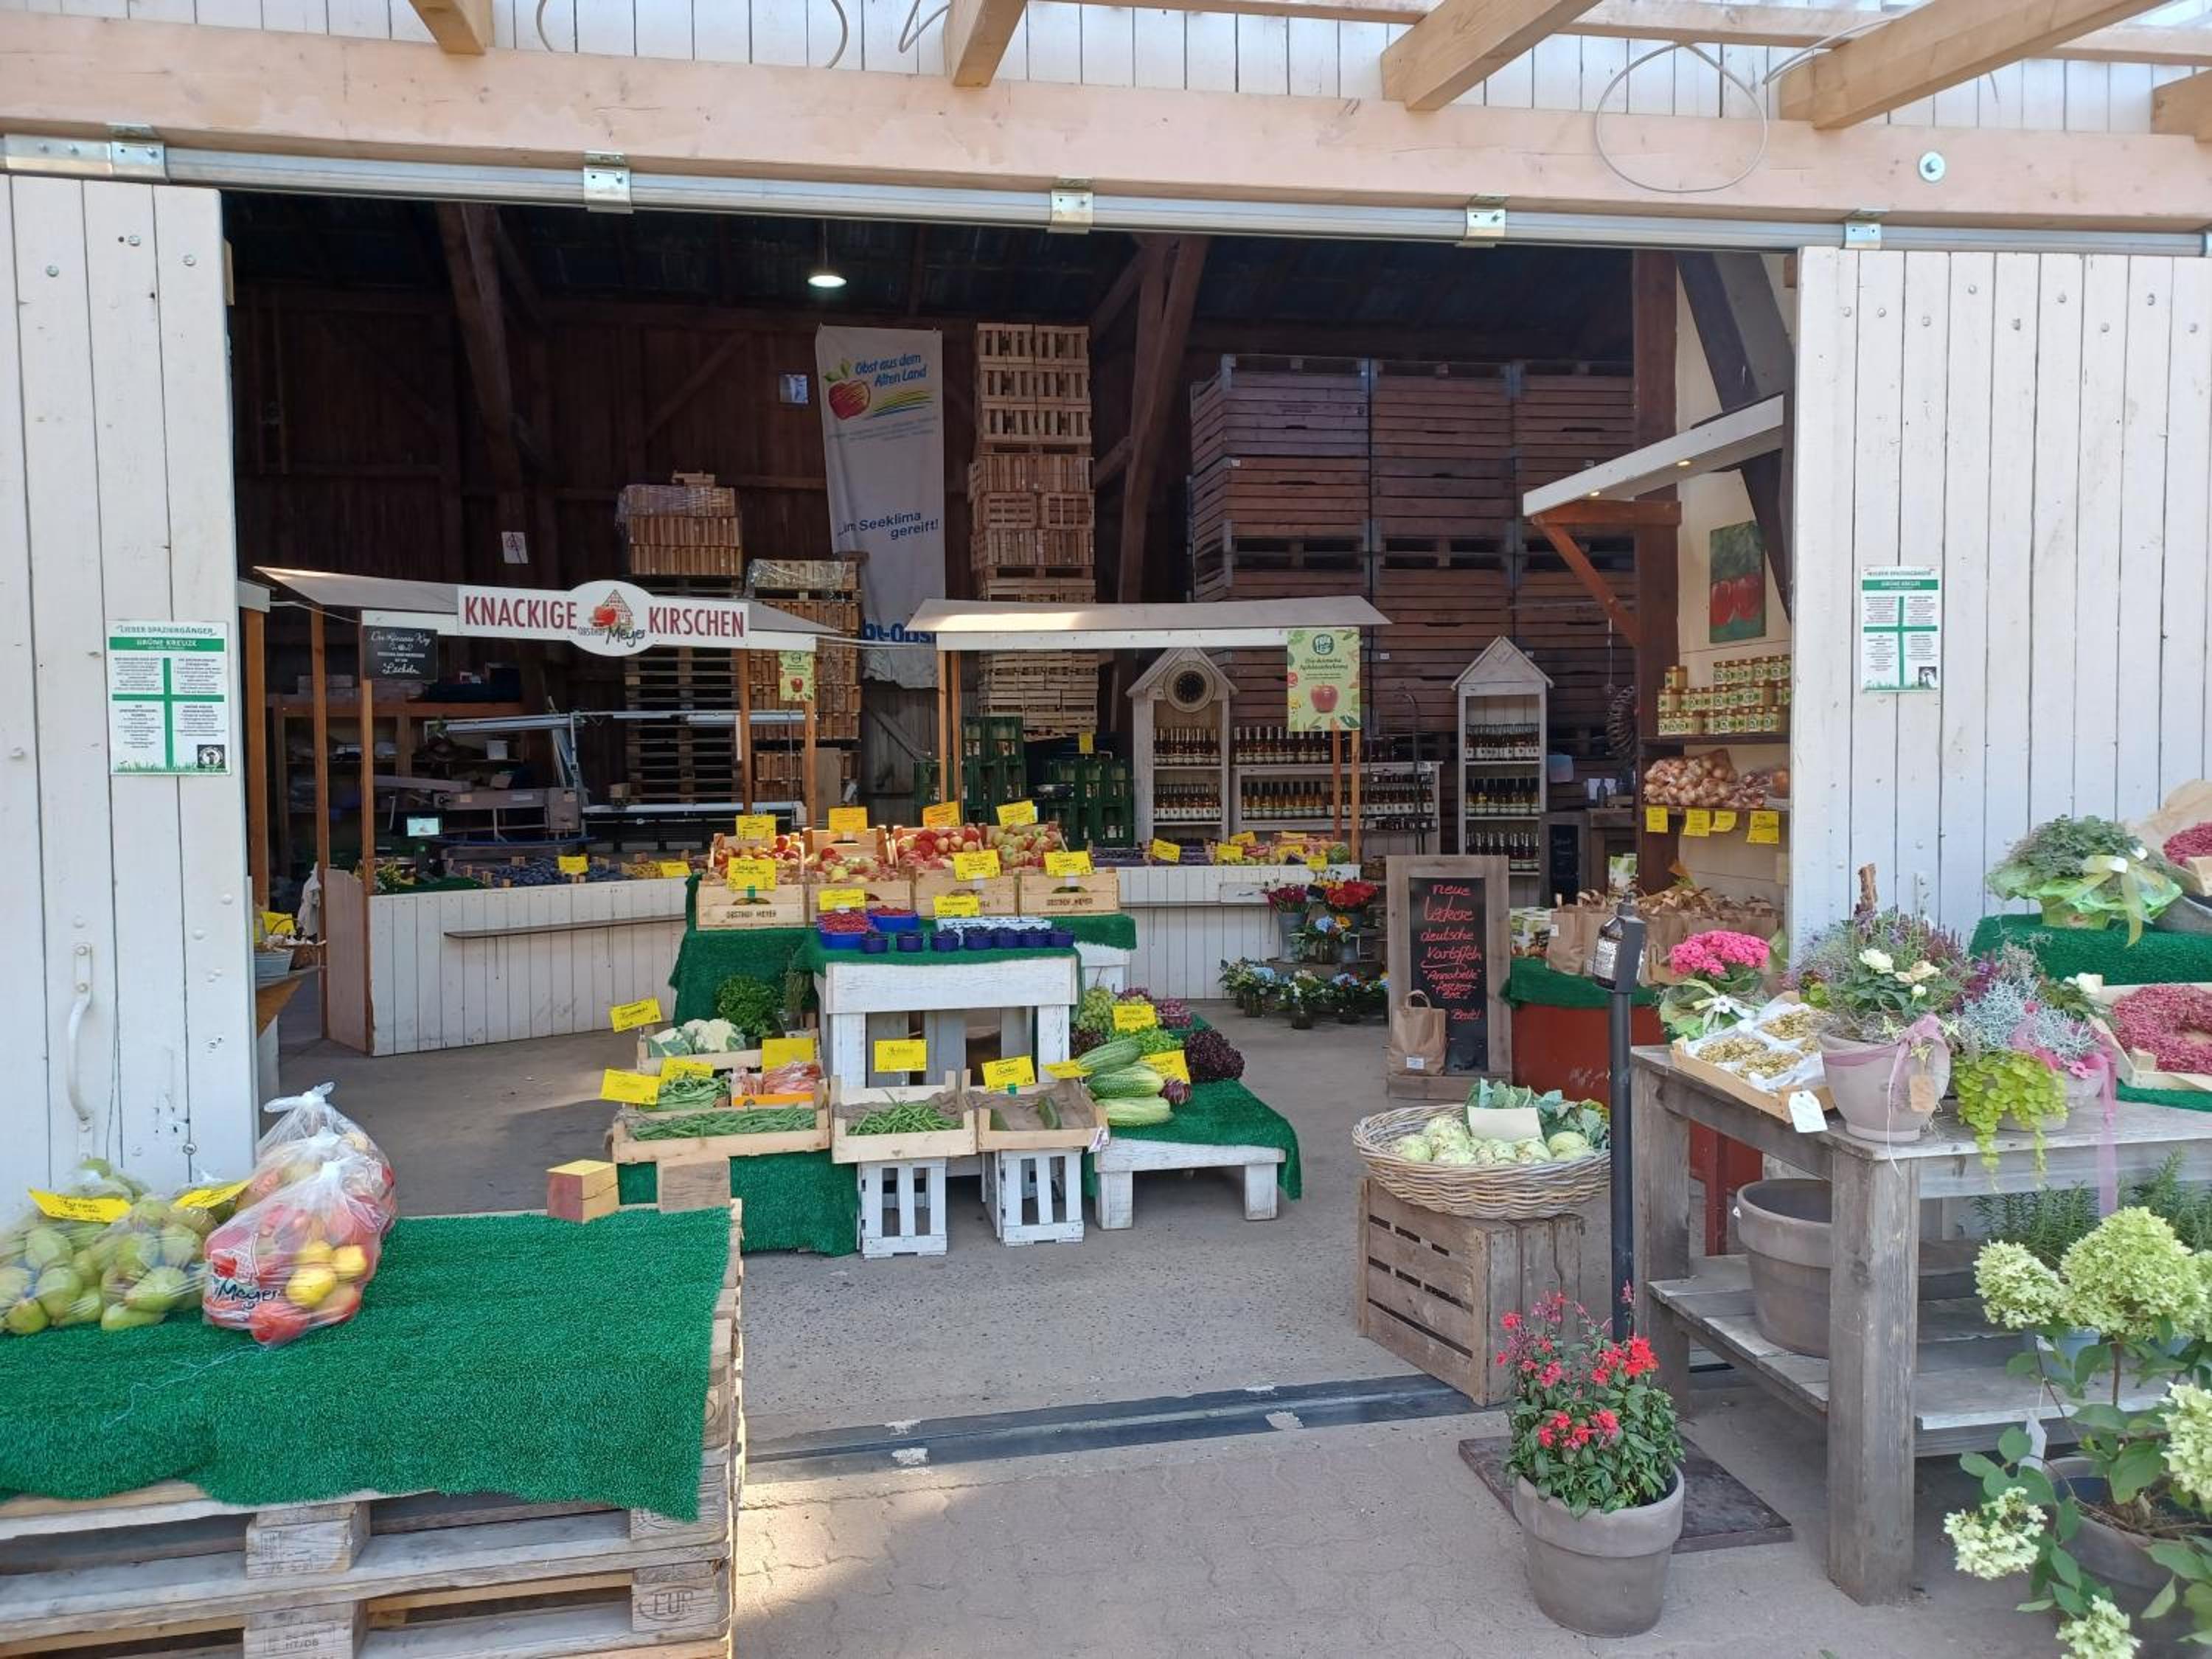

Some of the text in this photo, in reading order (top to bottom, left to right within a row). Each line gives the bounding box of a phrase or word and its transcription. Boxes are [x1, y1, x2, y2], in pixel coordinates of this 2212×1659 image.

[855, 353, 921, 375] Obst aus dem
[902, 364, 928, 381] Land
[859, 512, 921, 531] Seeklima
[891, 518, 939, 540] gereift!
[465, 596, 745, 638] KNACKIGE KIRSCHEN
[119, 625, 213, 635] LIEBER SPAZIERGÄNGER
[605, 625, 646, 647] Meyer
[1433, 885, 1471, 896] neue
[1421, 926, 1474, 942] deutsche
[216, 1279, 281, 1310] Meyer
